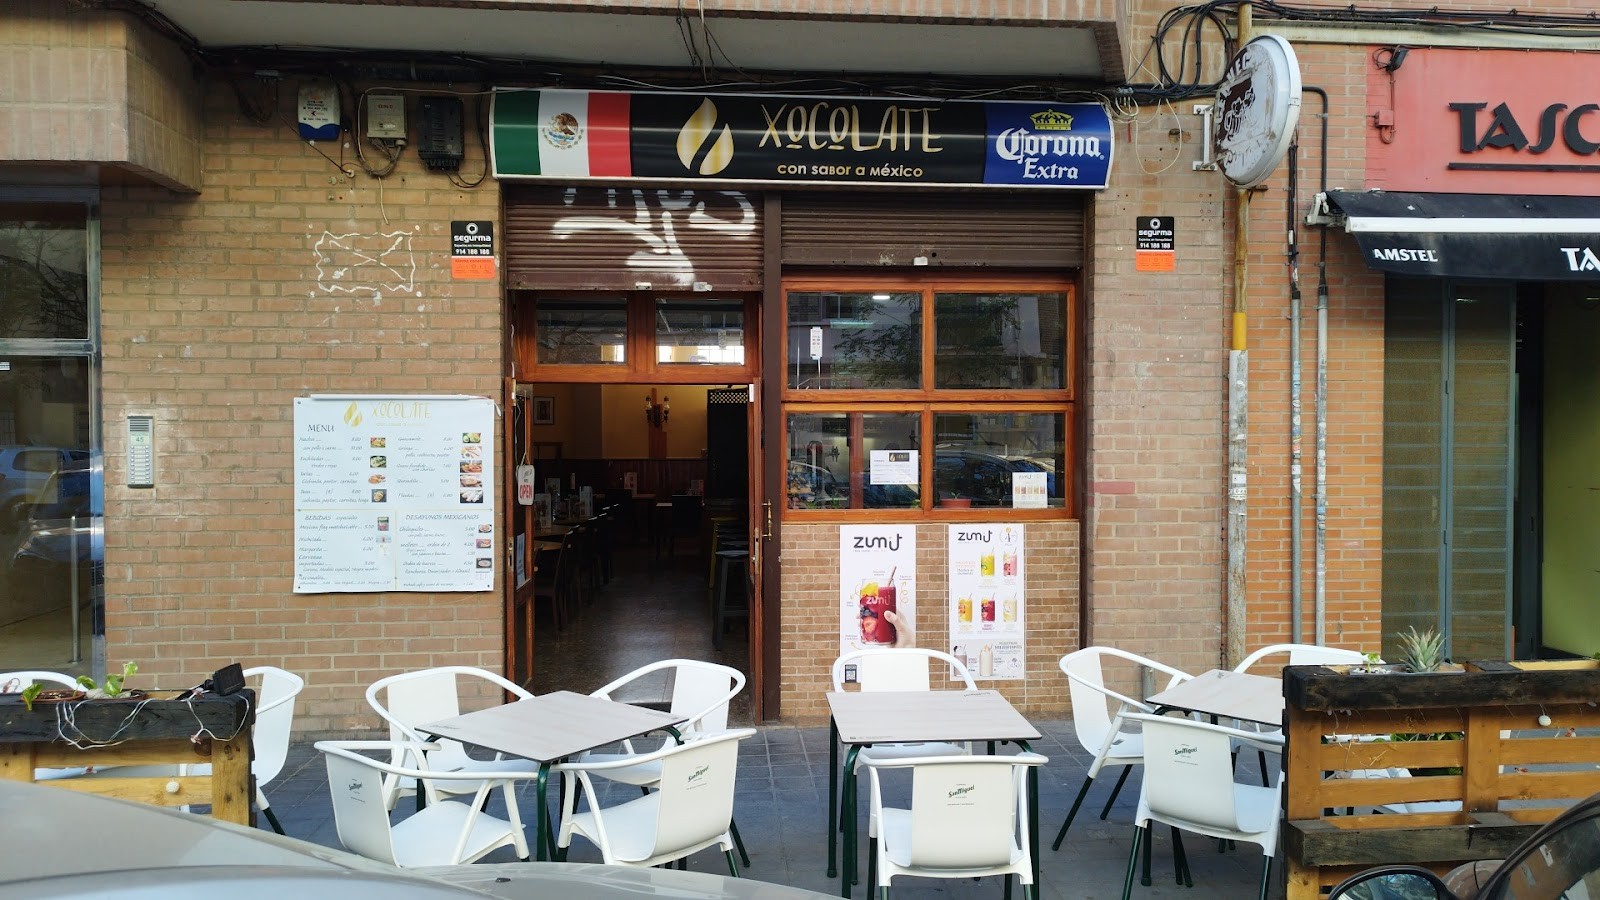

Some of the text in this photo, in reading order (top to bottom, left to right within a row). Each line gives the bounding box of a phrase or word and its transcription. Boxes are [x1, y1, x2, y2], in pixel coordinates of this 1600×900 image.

[758, 101, 943, 153] XOCOLATE
[1446, 102, 1600, 157] TASC
[996, 128, 1102, 163] Corona
[777, 164, 807, 175] con
[855, 167, 865, 176] a
[1023, 156, 1079, 183] Extra
[454, 235, 491, 243] segurma
[1138, 229, 1173, 237] segurma
[1373, 249, 1438, 263] AMSTEL
[372, 402, 432, 419] XOCOLATE
[307, 424, 335, 433] MENU
